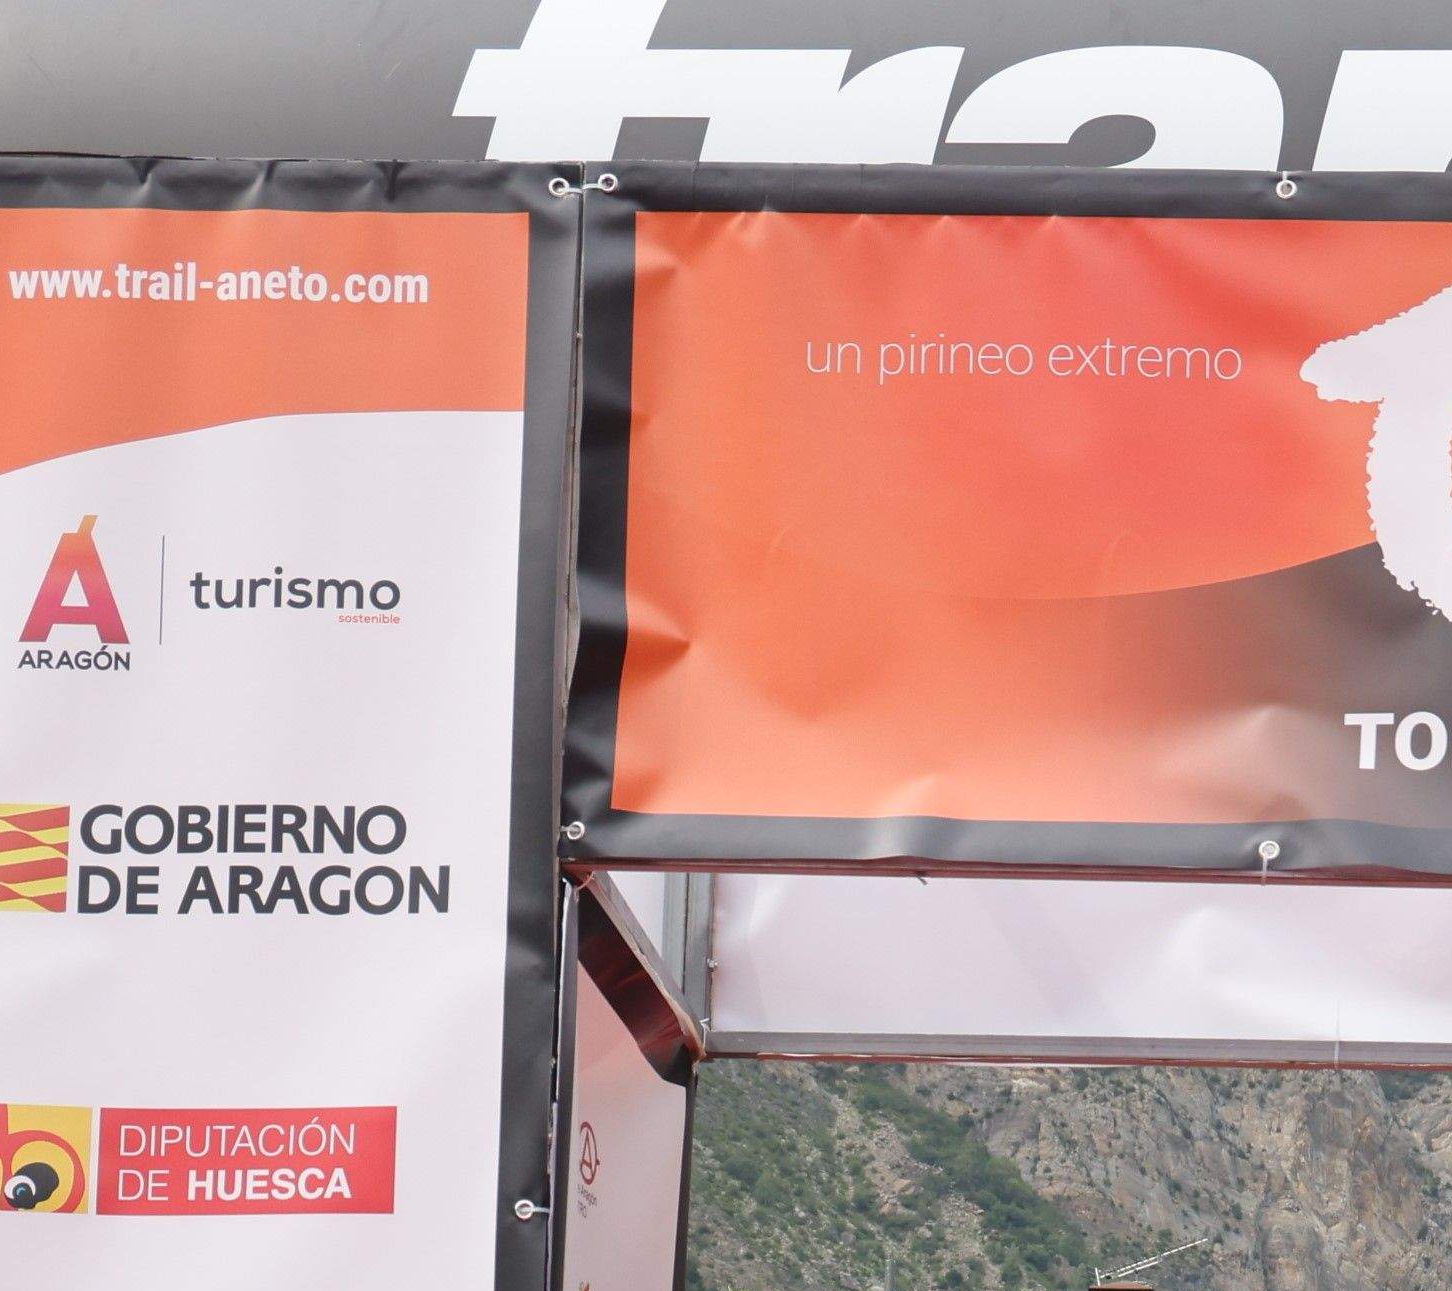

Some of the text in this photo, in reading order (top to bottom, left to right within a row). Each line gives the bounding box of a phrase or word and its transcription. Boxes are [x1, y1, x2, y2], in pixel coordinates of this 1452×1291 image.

[8, 262, 430, 304] www.trail-aneto.com
[805, 332, 1243, 384] un pirineo extremo
[190, 566, 401, 611] turismo
[338, 613, 401, 625] sostenible
[17, 645, 131, 671] ARAGÓN
[79, 805, 407, 855] GOBIERNO
[78, 865, 451, 916] DE ARAGON
[118, 1116, 355, 1158] DIPUTACIÓN
[117, 1169, 352, 1201] DE HUESCA
